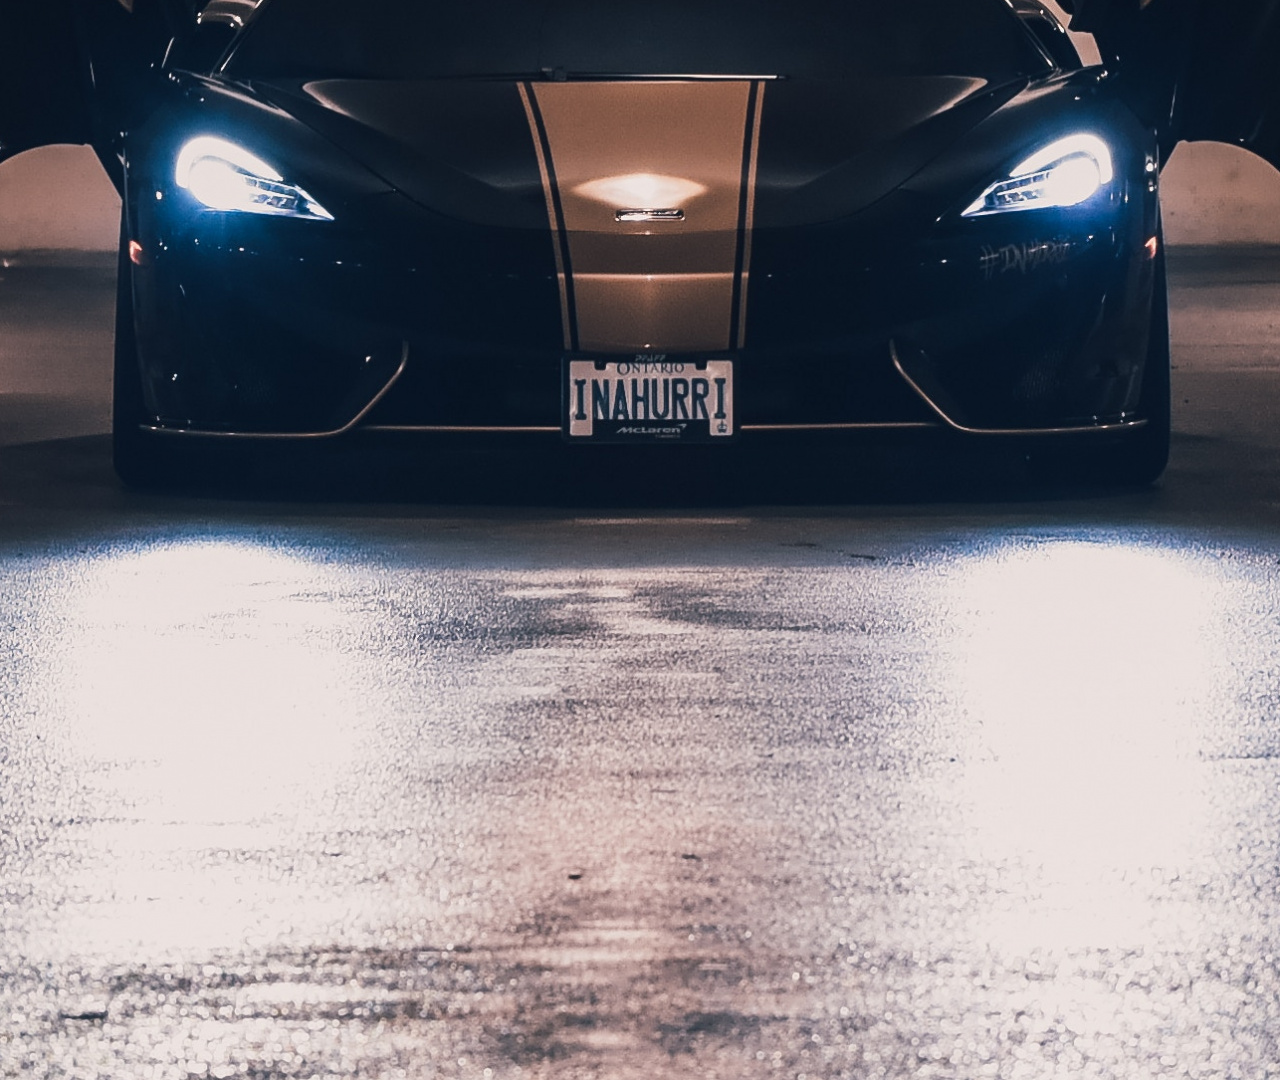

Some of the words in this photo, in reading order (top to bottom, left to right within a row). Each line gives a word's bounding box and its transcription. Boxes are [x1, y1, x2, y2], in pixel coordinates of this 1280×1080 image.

[617, 362, 684, 375] ONTARIO
[574, 378, 726, 420] INAHURRI
[616, 425, 682, 434] McLaren
